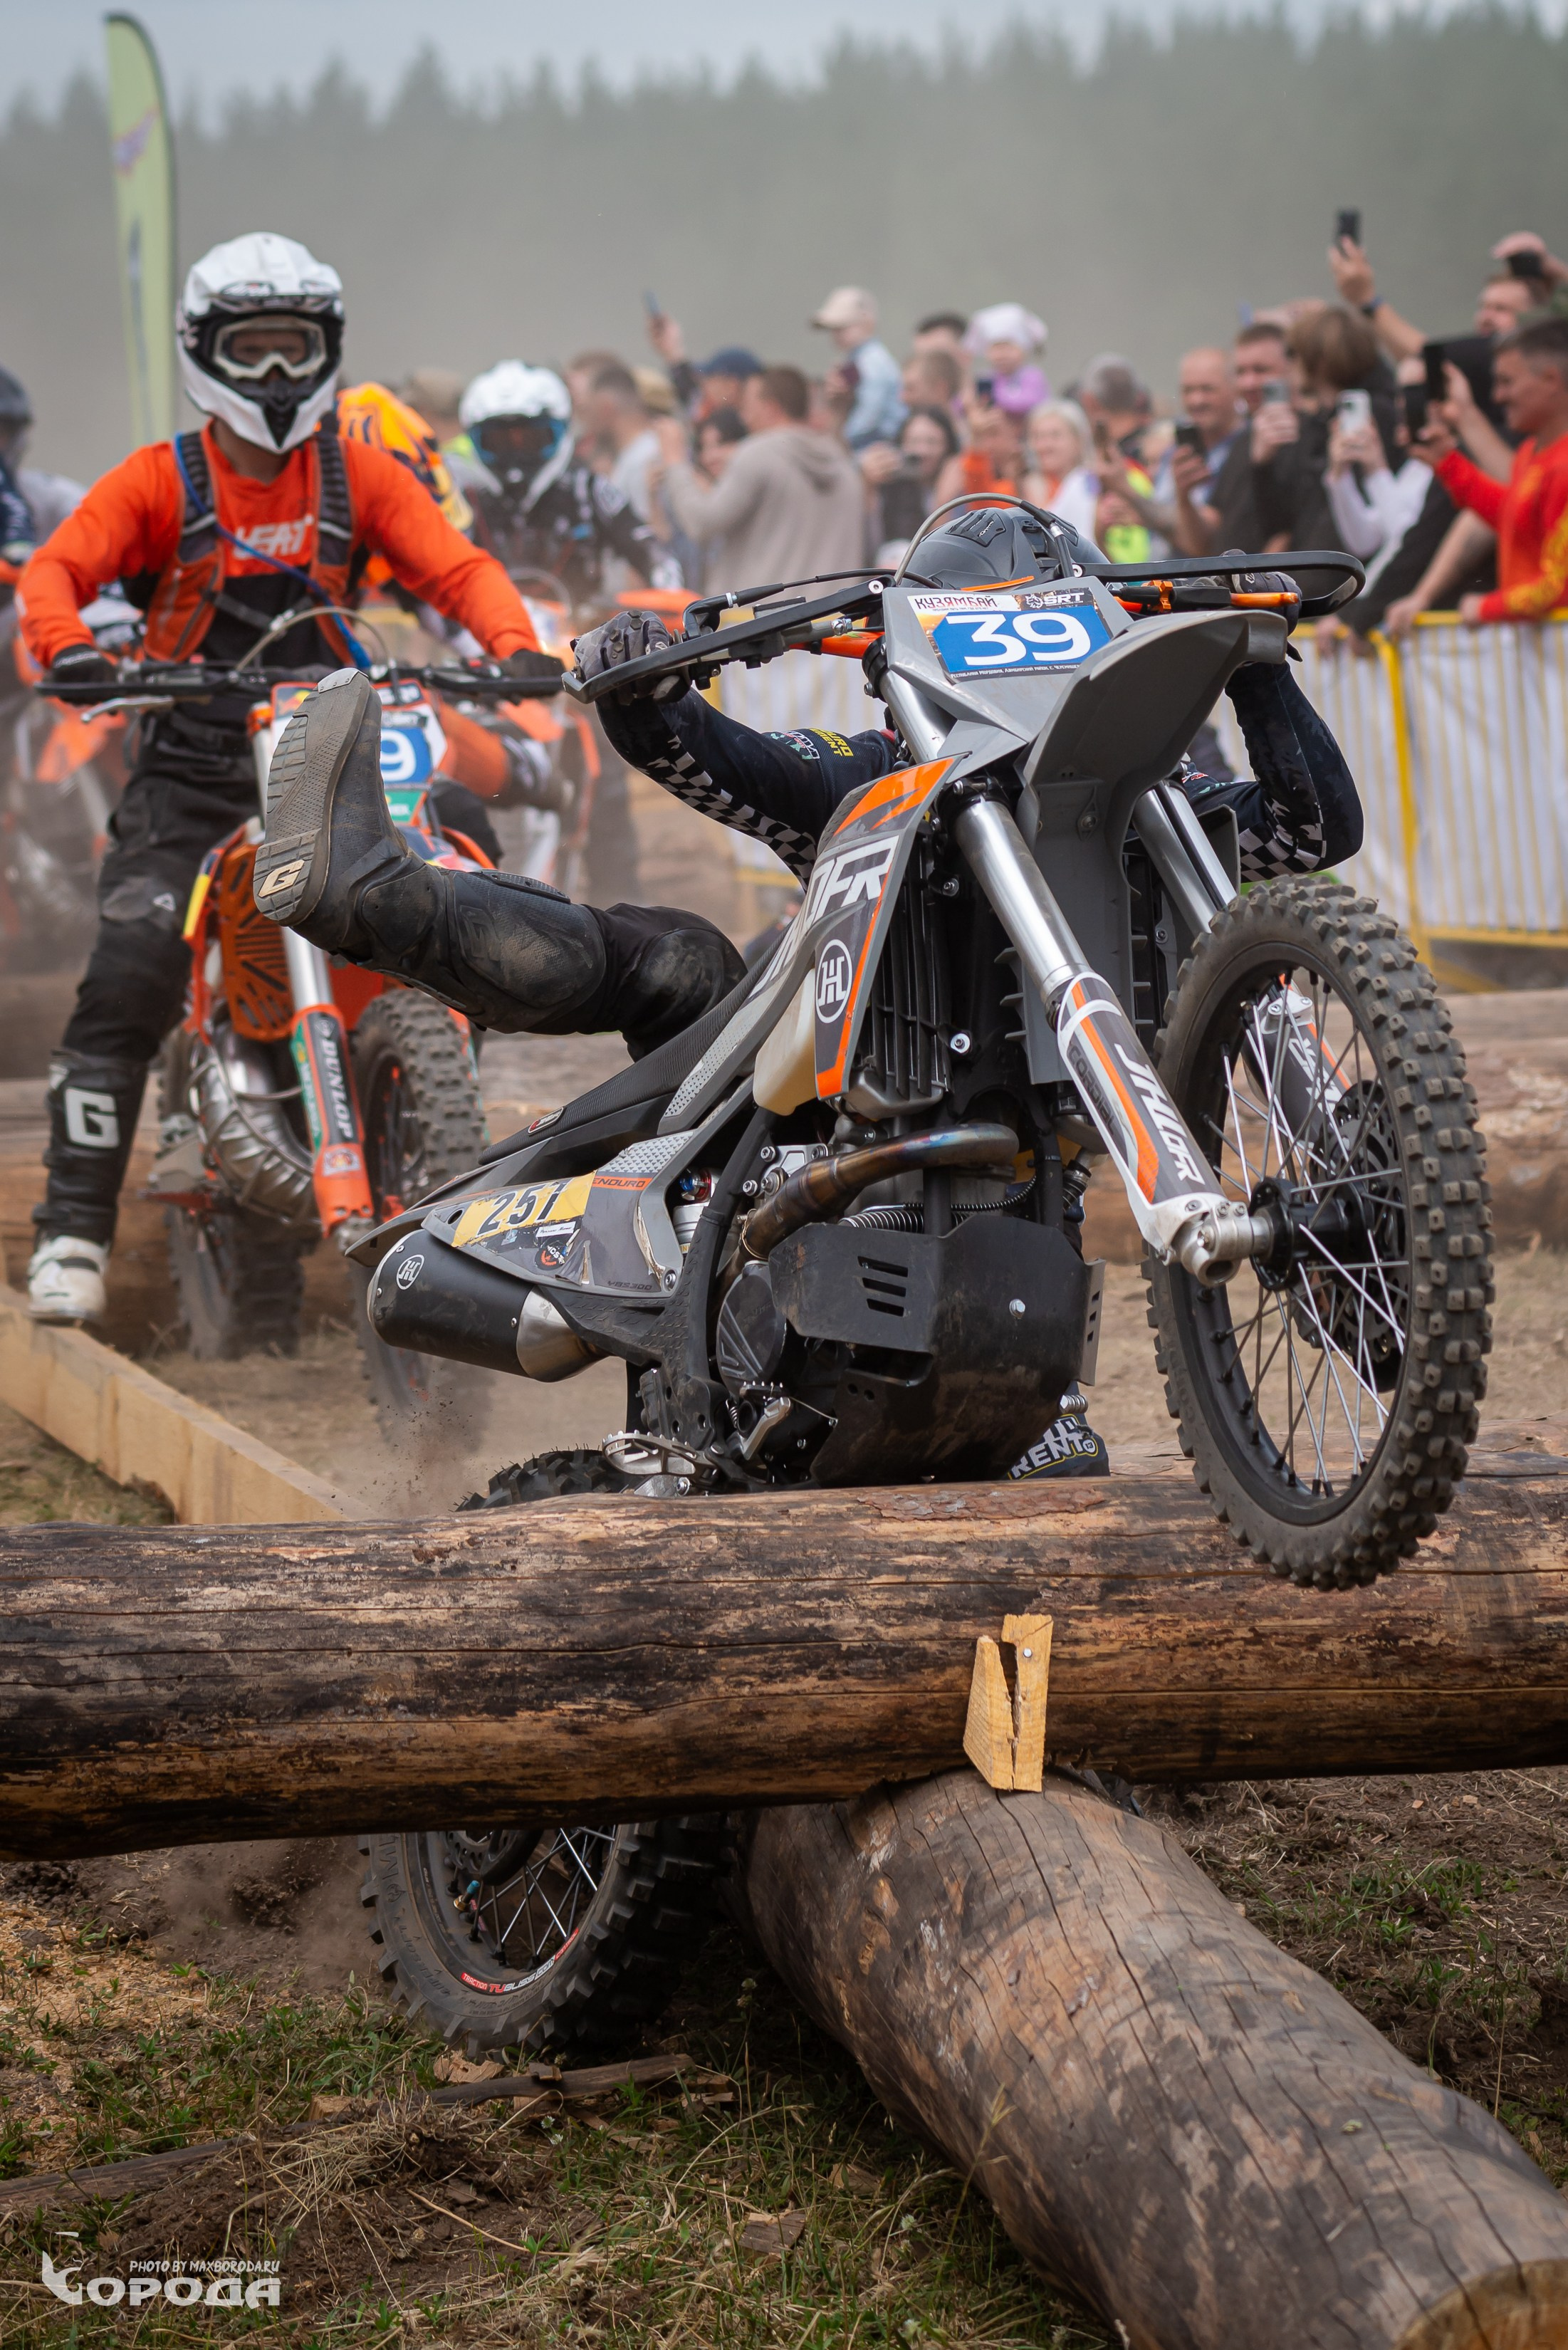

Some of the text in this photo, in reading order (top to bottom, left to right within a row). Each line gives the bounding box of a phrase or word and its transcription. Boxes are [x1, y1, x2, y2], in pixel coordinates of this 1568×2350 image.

[914, 595, 998, 610] КУЗЯМБАЙ
[1043, 592, 1084, 605] SRT
[946, 612, 1092, 666] 39
[320, 1038, 354, 1139] DUNLOP
[1068, 1045, 1114, 1136] CORDIAL
[592, 1177, 646, 1188] ENDURO
[476, 1177, 575, 1238] 257
[463, 1973, 487, 1990] TRACTION
